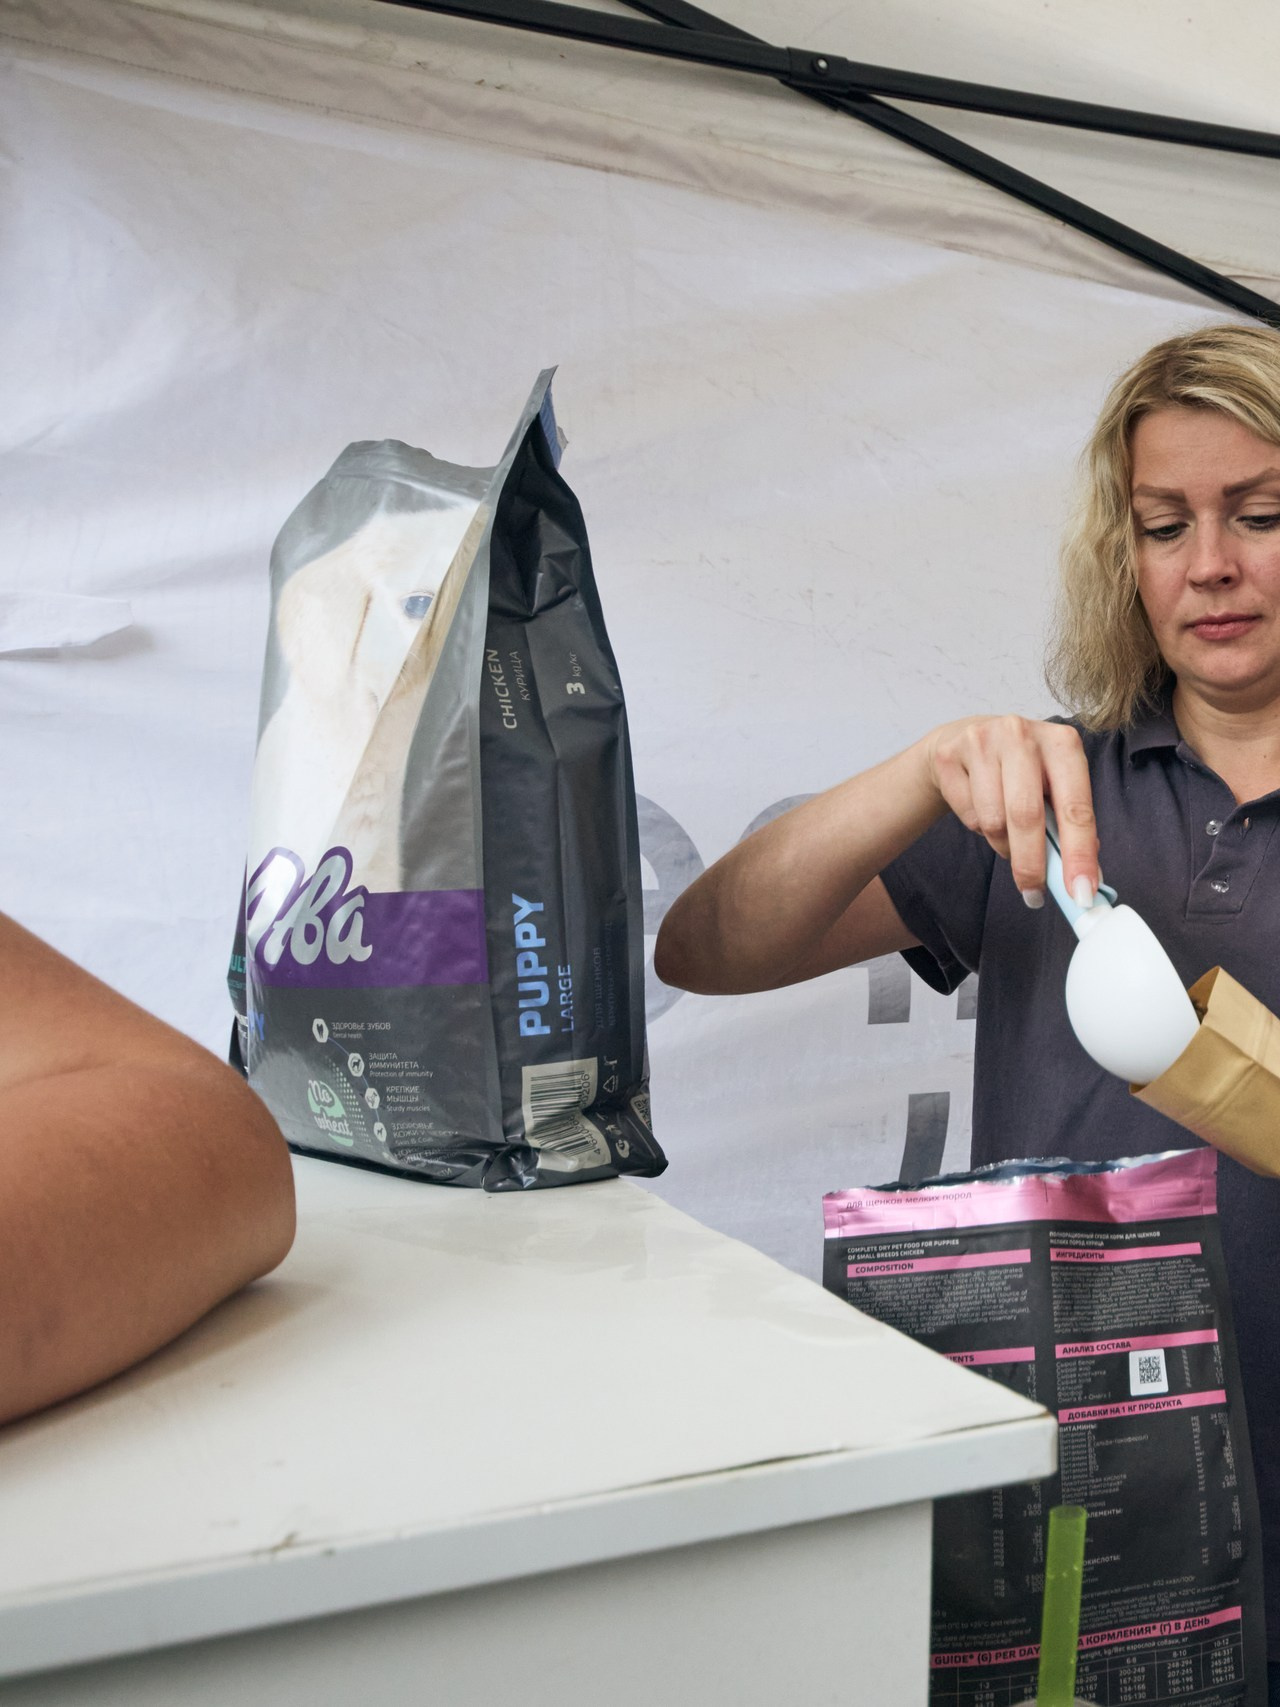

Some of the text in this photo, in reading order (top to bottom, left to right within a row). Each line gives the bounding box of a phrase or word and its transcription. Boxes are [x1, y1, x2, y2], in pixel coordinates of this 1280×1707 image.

[509, 650, 530, 701] КУРИЦА
[486, 648, 517, 729] CHICKEN
[566, 682, 585, 695] 3
[511, 893, 551, 1037] PUPPY
[557, 964, 575, 1032] LARGE
[331, 1022, 391, 1031] ЗДОРОВЬЕ ЗУБОВ
[369, 1052, 397, 1061] ЗАЩИТА
[369, 1061, 419, 1069] ИММУНИТЕТА
[405, 1071, 433, 1079] immunity
[846, 1191, 972, 1209] для щенков мелких пород
[1124, 1232, 1136, 1240] ДЛЯ
[1137, 1230, 1160, 1239] ЩЕНКОВ
[847, 1245, 877, 1253] COMPLETE
[878, 1244, 891, 1252] DRY
[903, 1241, 920, 1249] FOOD
[921, 1240, 933, 1248] FOR
[934, 1238, 960, 1246] PUPPIES
[857, 1252, 876, 1260] SMALL
[900, 1249, 925, 1257] CHICKEN
[1055, 1250, 1104, 1259] ИНГРЕДИЕНТЫ
[855, 1262, 914, 1274] COMPOSITION
[1062, 1341, 1131, 1354] АНАЛИЗ СОСТАВА
[1067, 1399, 1182, 1421] ДОБАВКИ НА 1 КГ ПРОДУКТА
[1083, 1555, 1120, 1566] ОКИСЛОТЫ:
[1160, 1623, 1172, 1635] (Г)
[1174, 1622, 1181, 1631] В
[1184, 1618, 1210, 1631] ДЕНЬ
[977, 1652, 992, 1664] (G)
[995, 1650, 1016, 1661] PER
[1018, 1646, 1041, 1657] DAY
[1172, 1649, 1187, 1658] 8-10
[1213, 1639, 1230, 1648] 10-12
